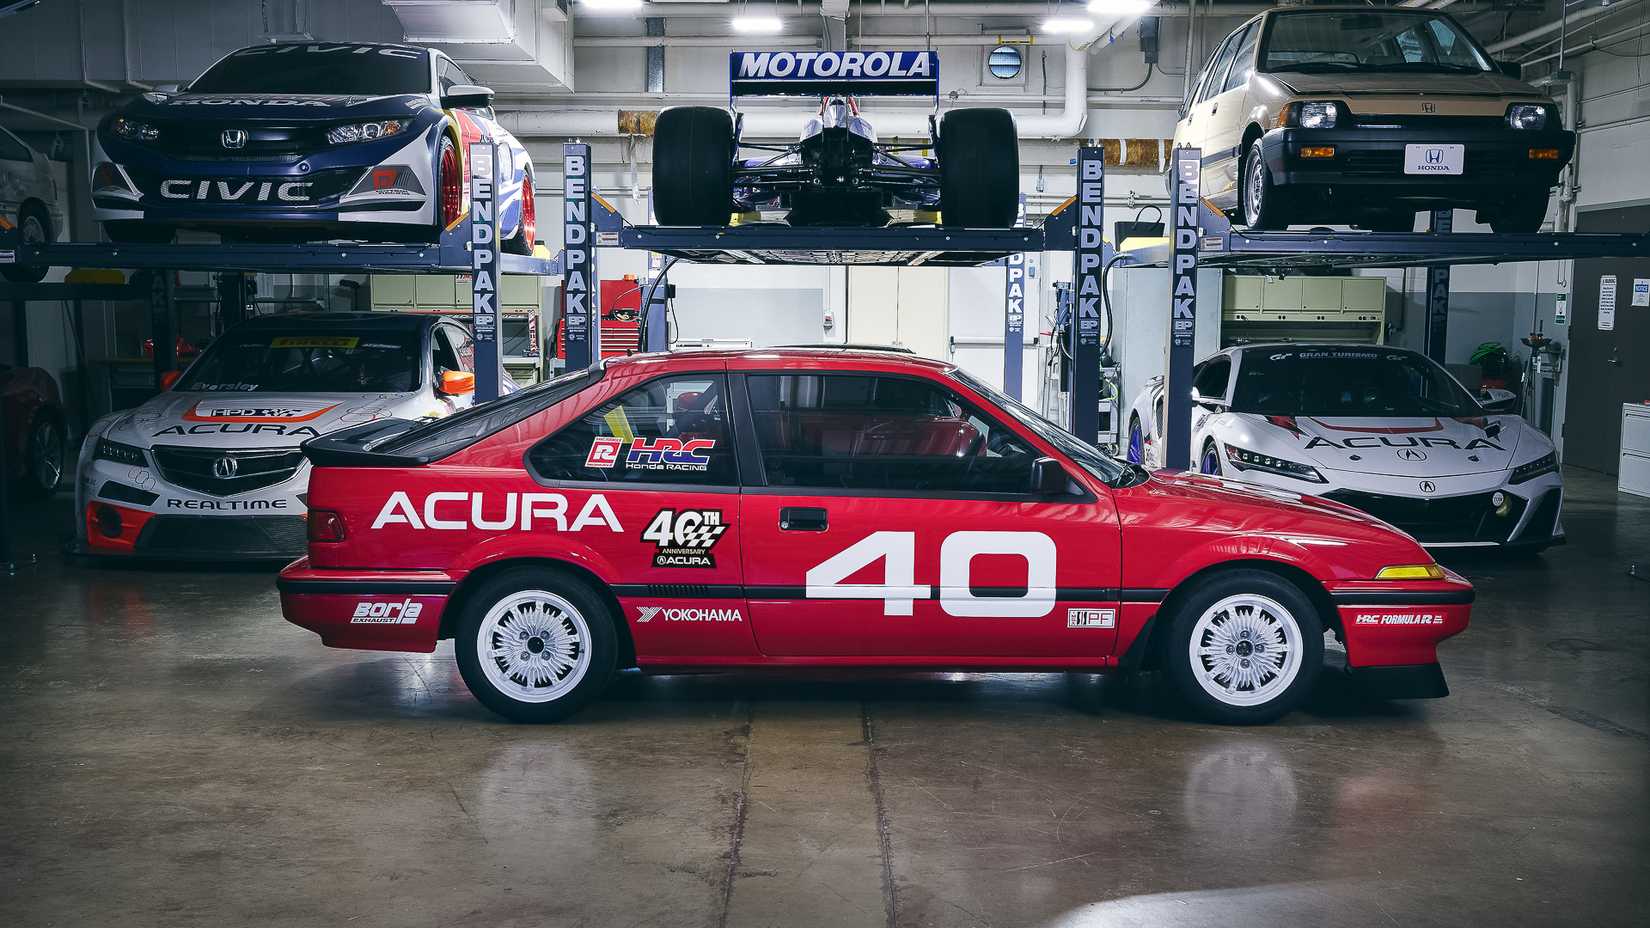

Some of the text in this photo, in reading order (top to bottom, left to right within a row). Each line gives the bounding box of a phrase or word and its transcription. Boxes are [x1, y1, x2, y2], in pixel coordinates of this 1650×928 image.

[738, 52, 931, 77] MOTOROLA
[160, 180, 313, 201] CIVIC
[152, 423, 321, 437] ACURA
[1304, 436, 1507, 451] ACURA
[626, 437, 716, 466] HRC
[625, 463, 664, 471] Honda
[167, 499, 287, 510] REALTIME
[371, 491, 625, 533] ACURA
[666, 556, 711, 566] ACURA
[806, 530, 1057, 618] 40
[662, 608, 743, 622] YOKOHAMA
[1355, 614, 1380, 625] HRC
[1380, 614, 1421, 625] FORMULA
